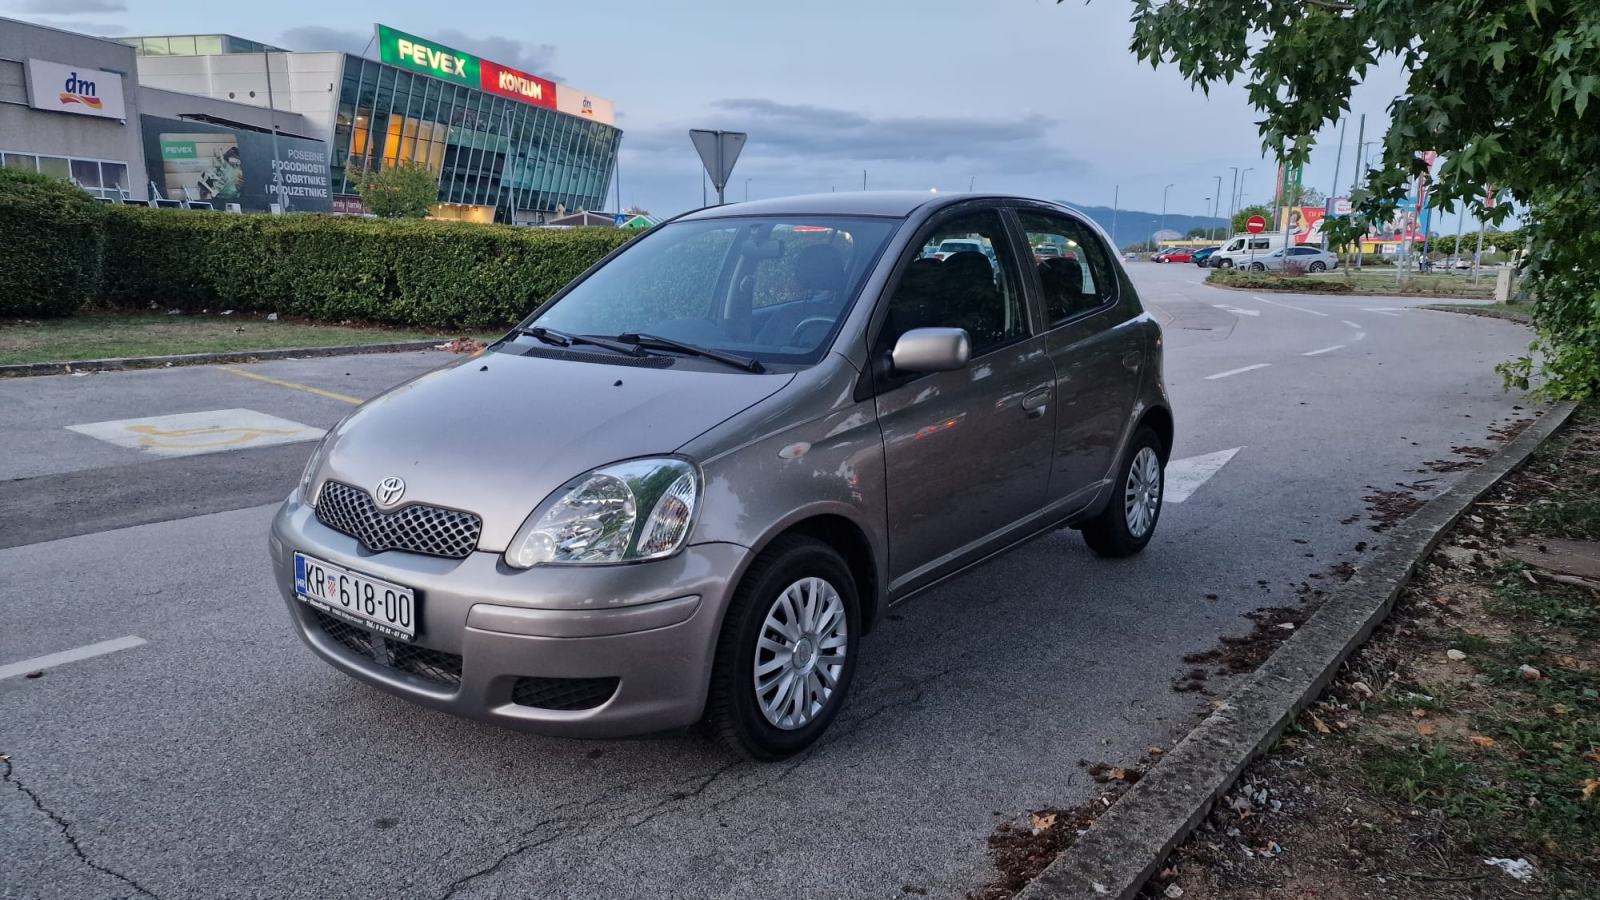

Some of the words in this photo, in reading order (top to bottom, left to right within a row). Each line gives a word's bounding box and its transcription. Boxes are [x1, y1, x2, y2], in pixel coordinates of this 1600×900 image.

[398, 39, 466, 78] PEVEX
[65, 72, 96, 97] dm
[499, 71, 542, 100] KONZUM
[288, 149, 325, 162] POSEBNE
[271, 160, 326, 174] POGODNOSTI
[286, 173, 327, 186] OBRTNIKE
[270, 184, 328, 198] PODUZETNIKE
[297, 578, 305, 589] HR
[306, 563, 325, 598] KR
